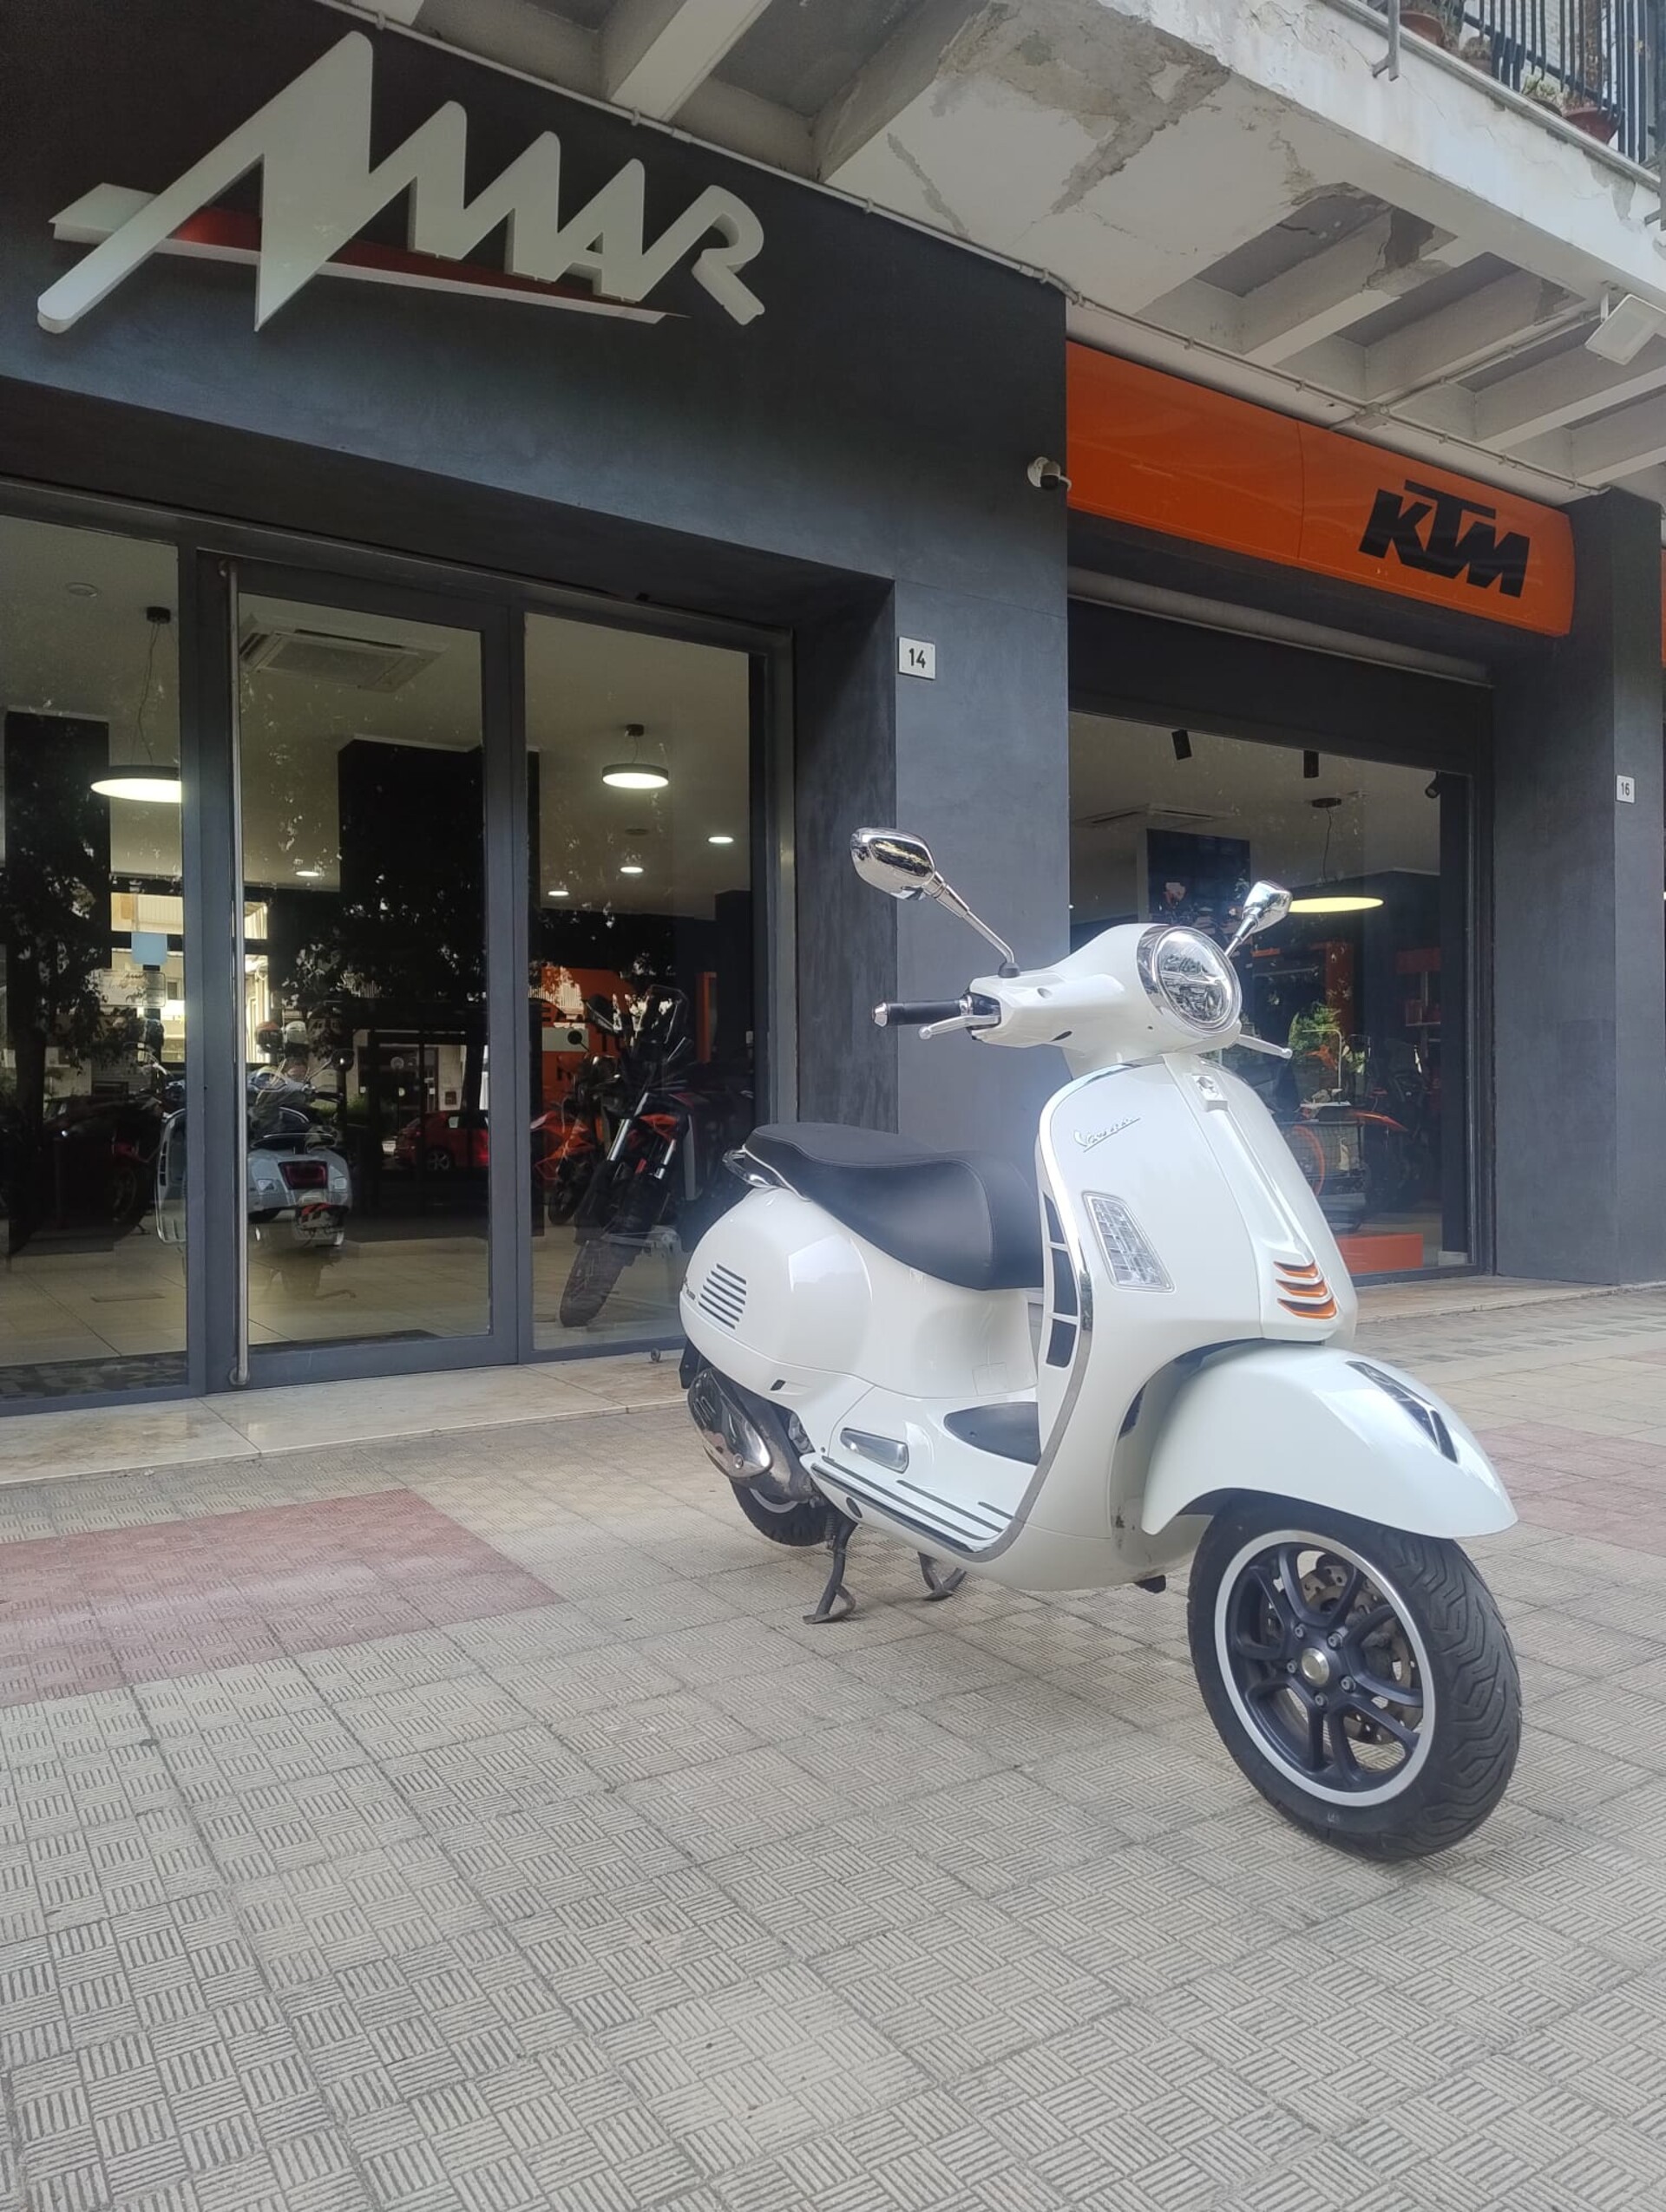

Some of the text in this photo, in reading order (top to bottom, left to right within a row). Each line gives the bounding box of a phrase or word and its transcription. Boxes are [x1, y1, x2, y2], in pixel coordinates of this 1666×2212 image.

[36, 30, 765, 333] AMAR
[1358, 480, 1530, 598] KTM
[909, 648, 926, 668] 14
[1621, 782, 1630, 795] 16
